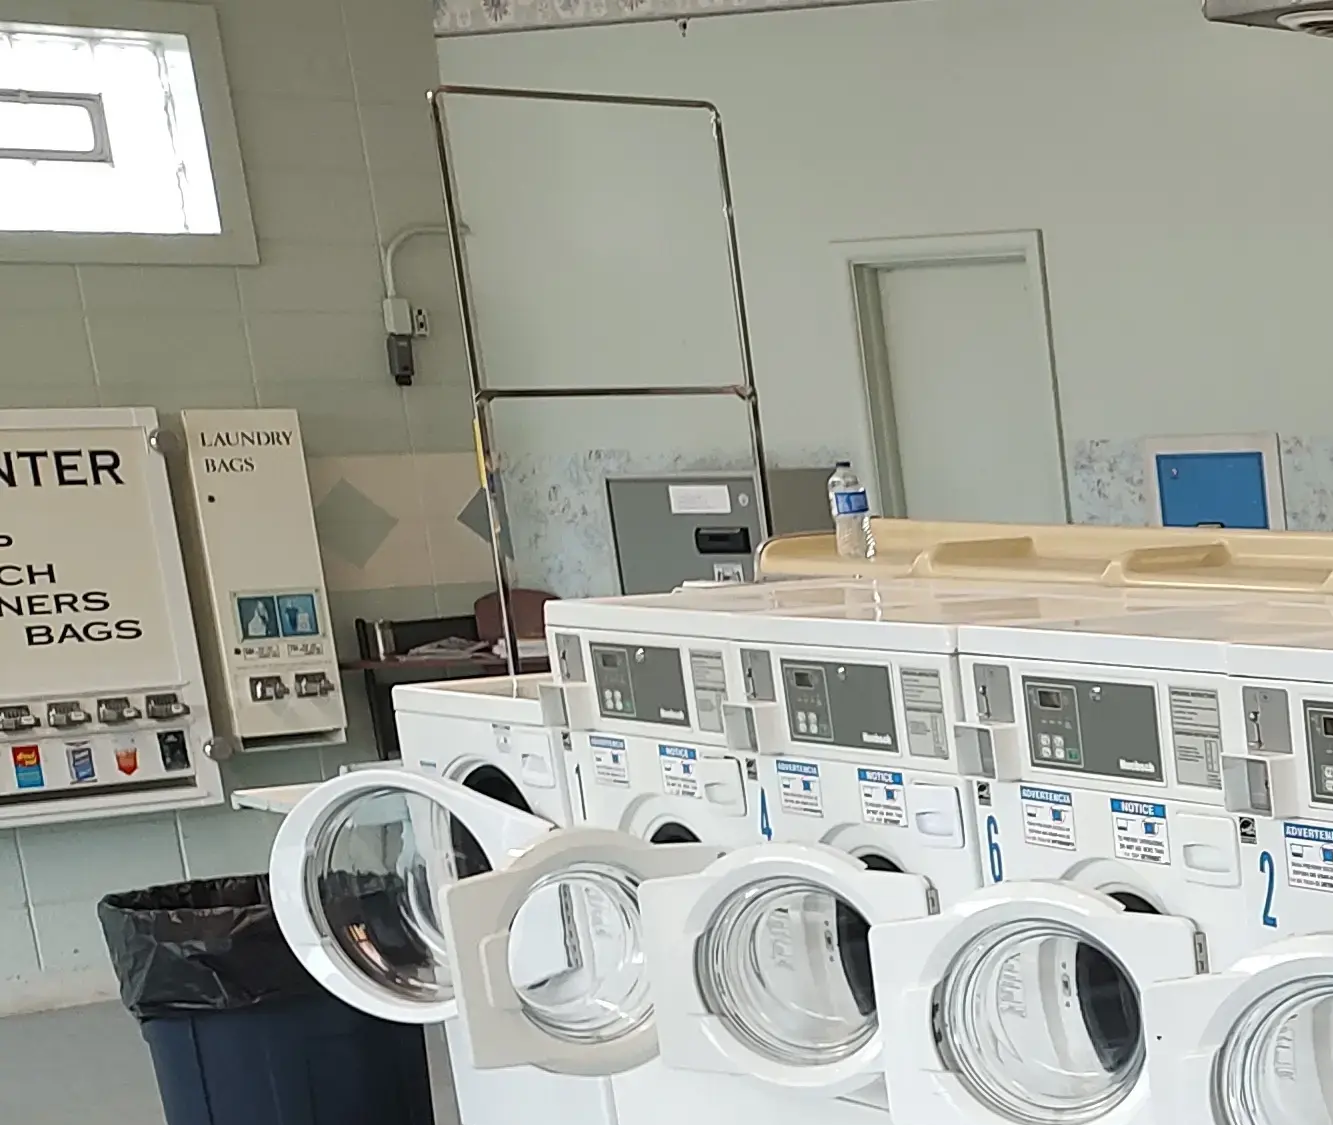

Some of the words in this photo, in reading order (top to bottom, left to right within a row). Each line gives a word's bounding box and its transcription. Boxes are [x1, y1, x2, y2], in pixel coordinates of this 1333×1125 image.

[200, 431, 293, 447] LAUNDRY
[204, 457, 255, 473] BAGS
[24, 619, 143, 646] BAGS
[760, 787, 773, 841] 4
[1121, 801, 1155, 816] NOTICE
[986, 814, 1003, 883] 6
[1259, 850, 1278, 928] 2
